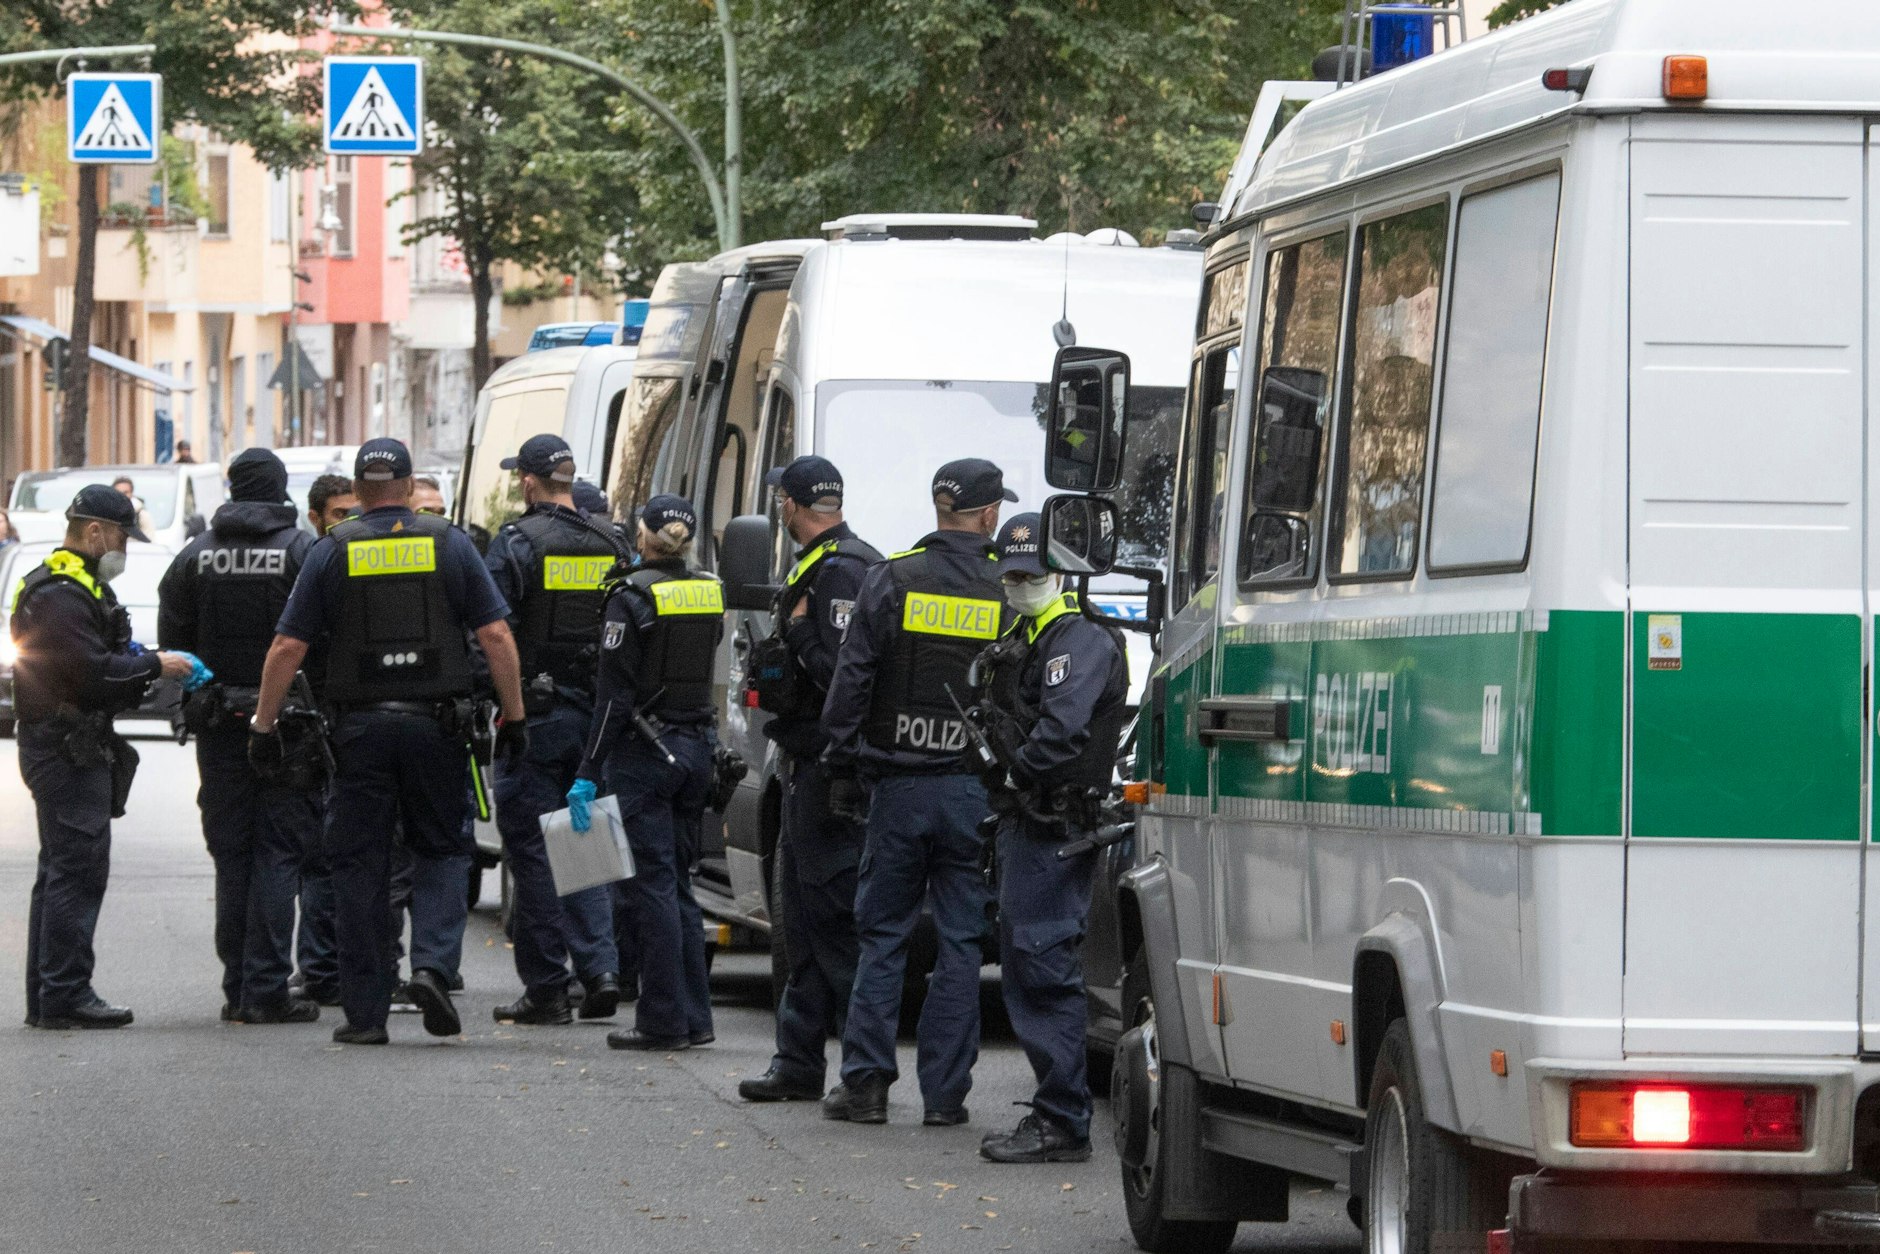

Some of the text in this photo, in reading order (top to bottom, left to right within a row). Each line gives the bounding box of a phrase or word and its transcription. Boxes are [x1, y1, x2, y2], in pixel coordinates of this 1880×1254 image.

[362, 450, 397, 463] POLIZEI
[811, 481, 843, 495] POLIZEI
[662, 509, 694, 524] POLIZEI
[353, 542, 431, 570] POLIZEI
[1005, 543, 1038, 554] POLIZEI
[197, 548, 286, 575] POLIZEI
[549, 561, 610, 584] POLIZE
[659, 585, 720, 609] POLIZEI
[909, 599, 994, 633] POLIZEI
[895, 713, 965, 751] POLIZ
[1312, 671, 1395, 774] POLIZEI
